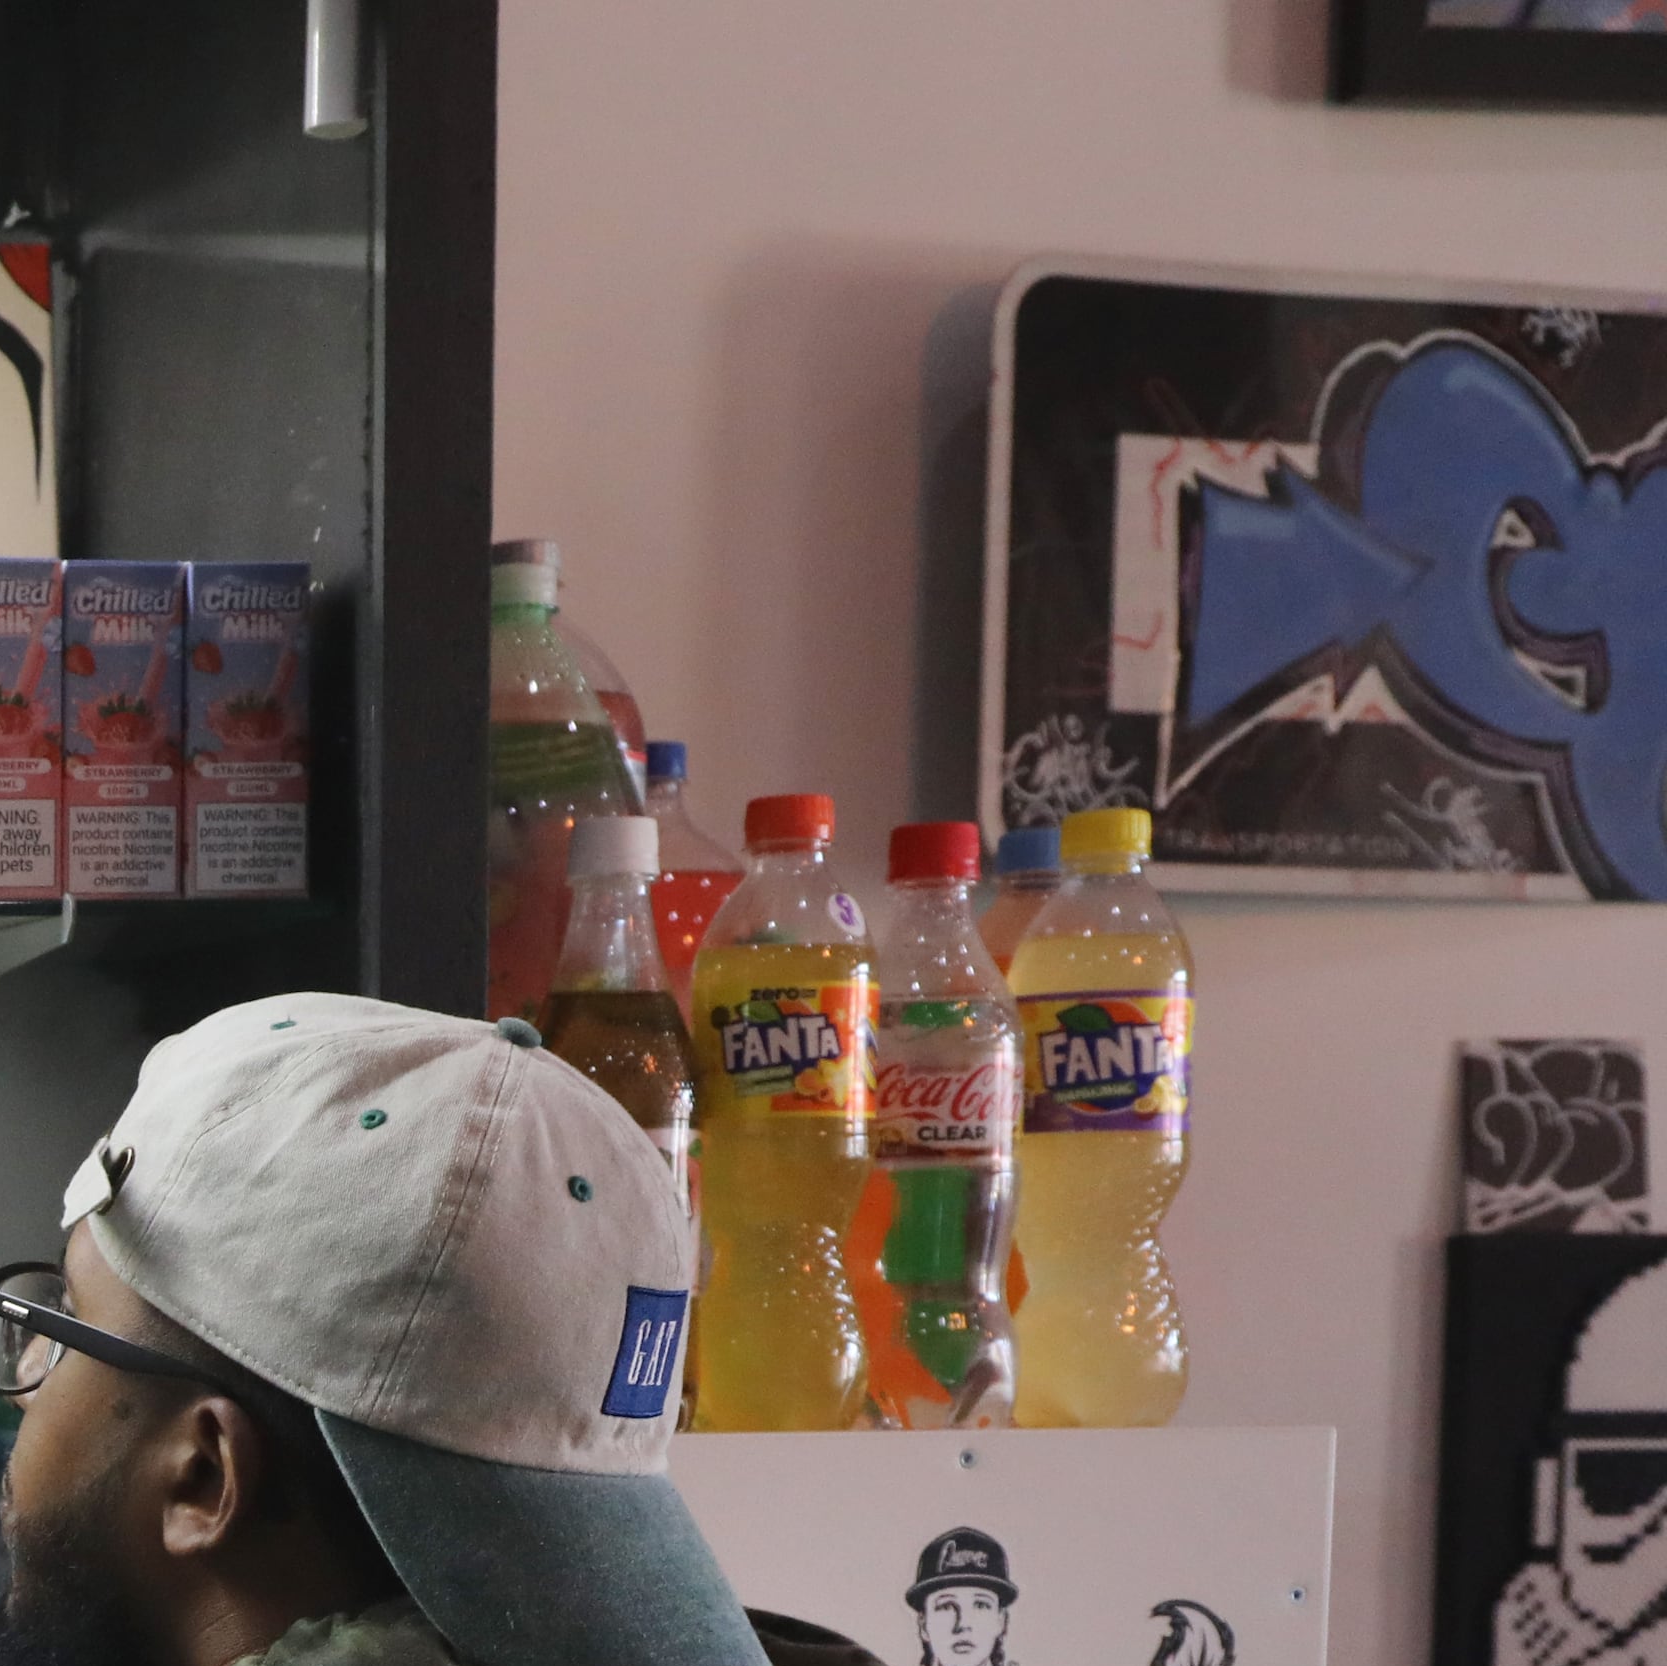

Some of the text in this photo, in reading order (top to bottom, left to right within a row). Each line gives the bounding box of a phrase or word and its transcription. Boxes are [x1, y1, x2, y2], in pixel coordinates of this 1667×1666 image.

[1, 829, 41, 844] away
[1, 859, 33, 875] pets
[723, 1014, 840, 1069] FANTA
[1041, 1025, 1174, 1085] FANTA
[918, 1126, 986, 1142] CLEAR
